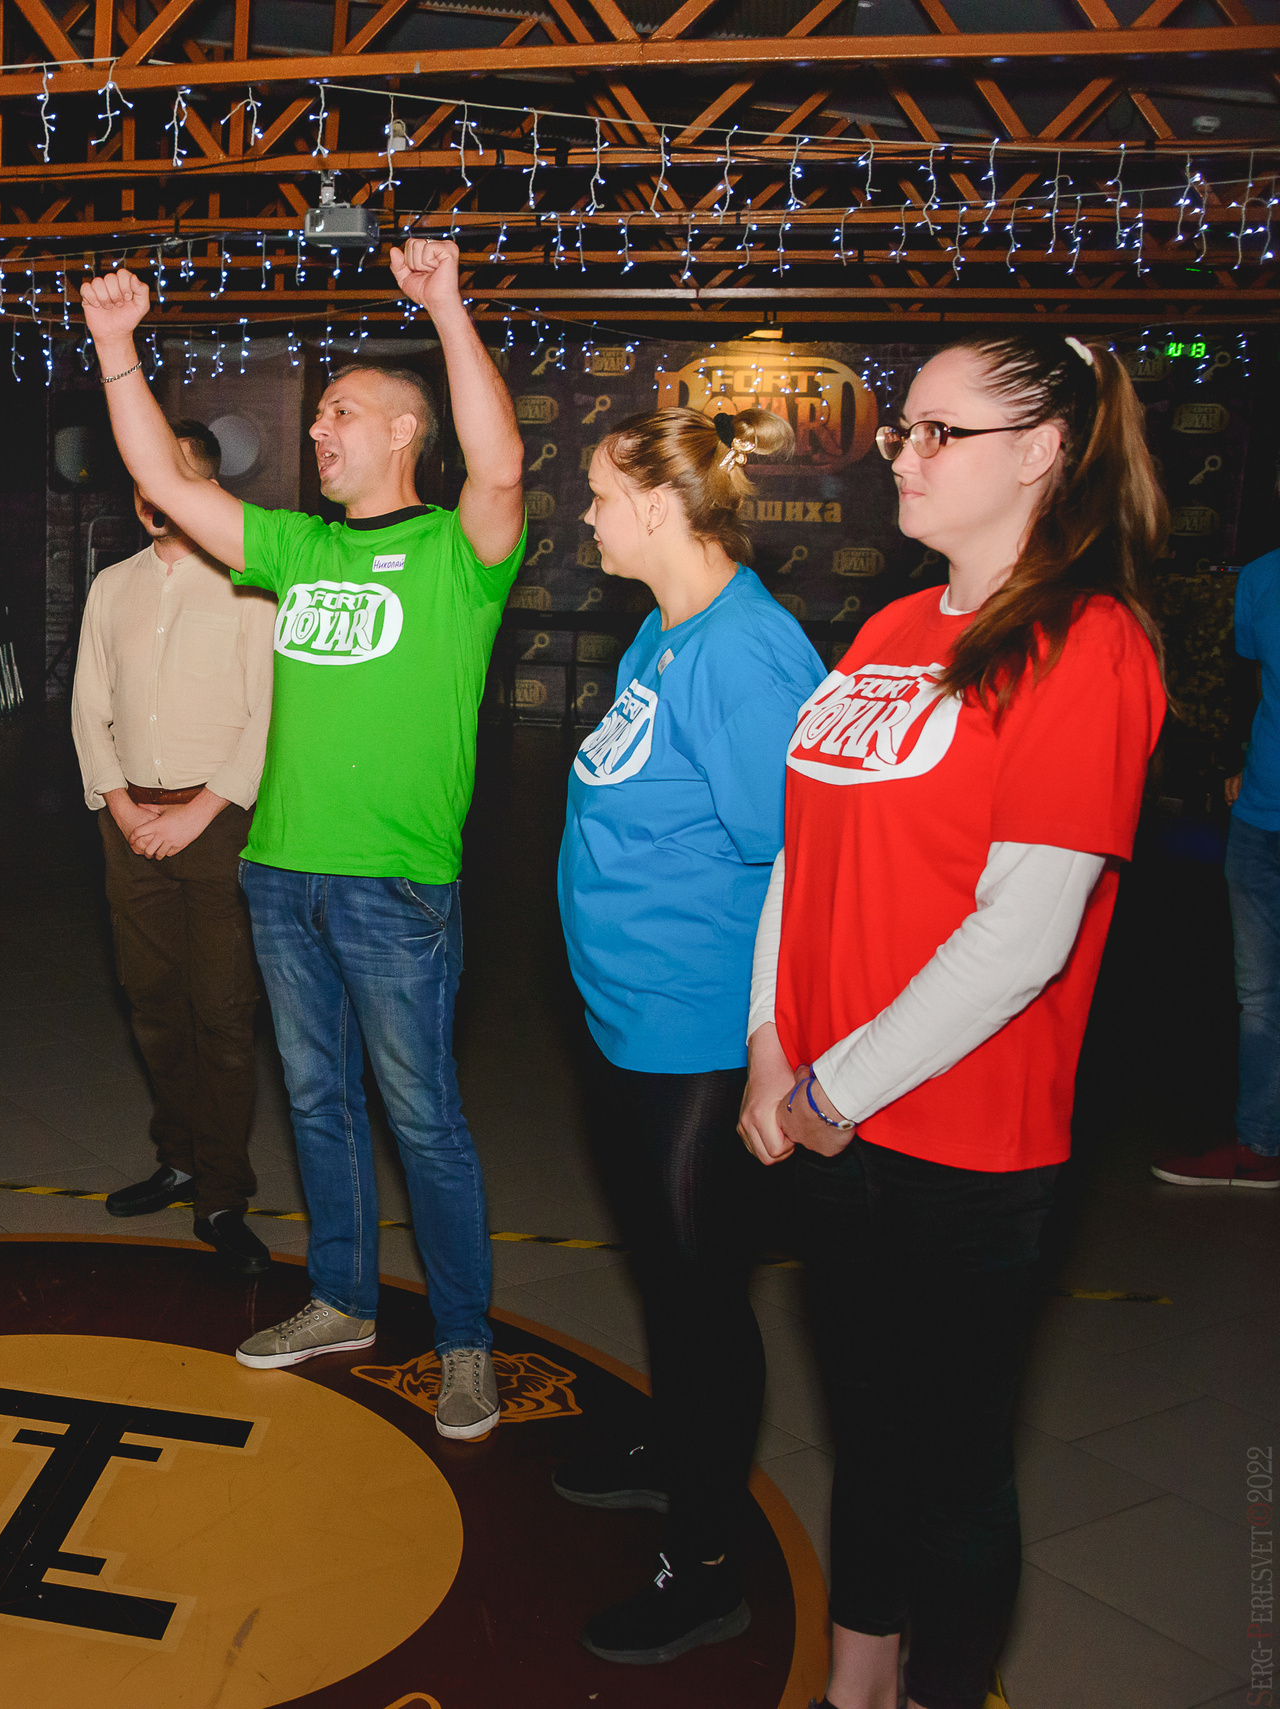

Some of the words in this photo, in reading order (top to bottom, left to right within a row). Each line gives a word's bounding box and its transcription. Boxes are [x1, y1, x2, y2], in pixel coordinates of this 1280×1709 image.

[712, 370, 816, 393] FORT
[742, 500, 842, 523] ашиха
[373, 558, 405, 570] Николай
[311, 591, 367, 610] FORT
[274, 588, 404, 657] BOYARD
[851, 677, 916, 699] FORT
